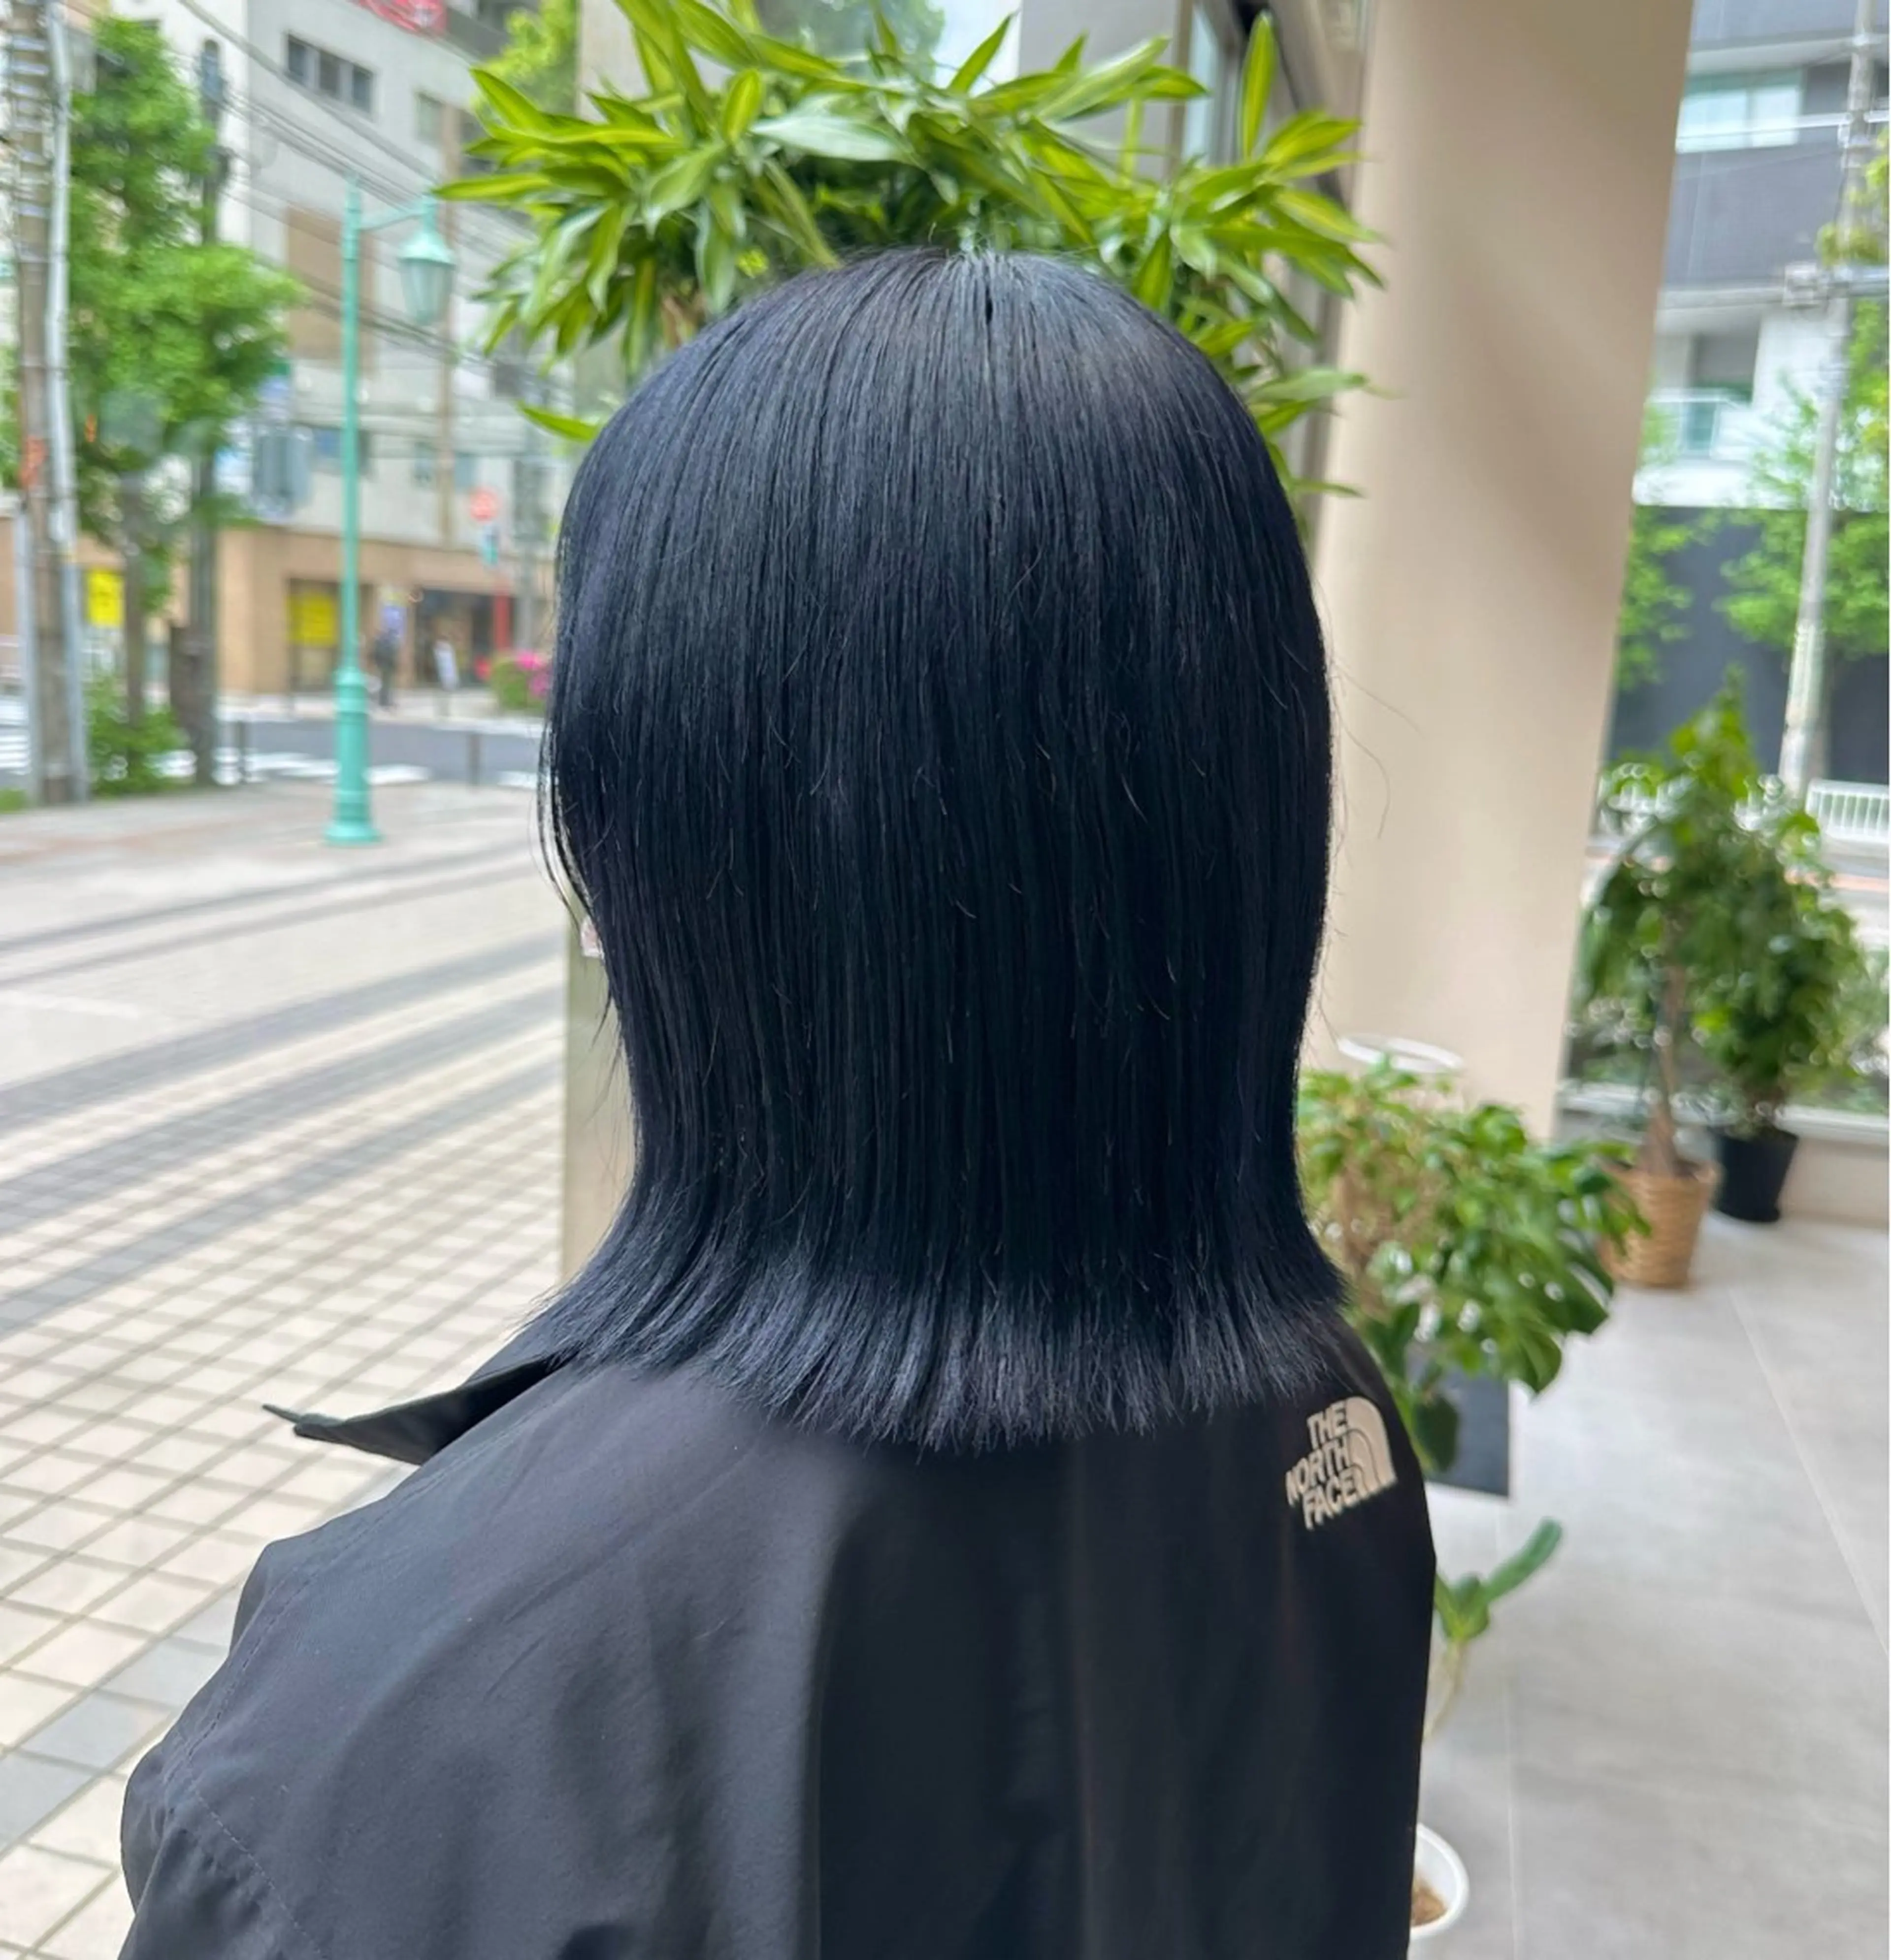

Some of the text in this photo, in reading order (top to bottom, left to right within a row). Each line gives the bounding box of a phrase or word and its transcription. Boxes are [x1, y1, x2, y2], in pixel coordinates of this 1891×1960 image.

[1306, 1400, 1347, 1450] THE
[1285, 1434, 1350, 1507] NORTH
[1303, 1467, 1359, 1531] FACE
